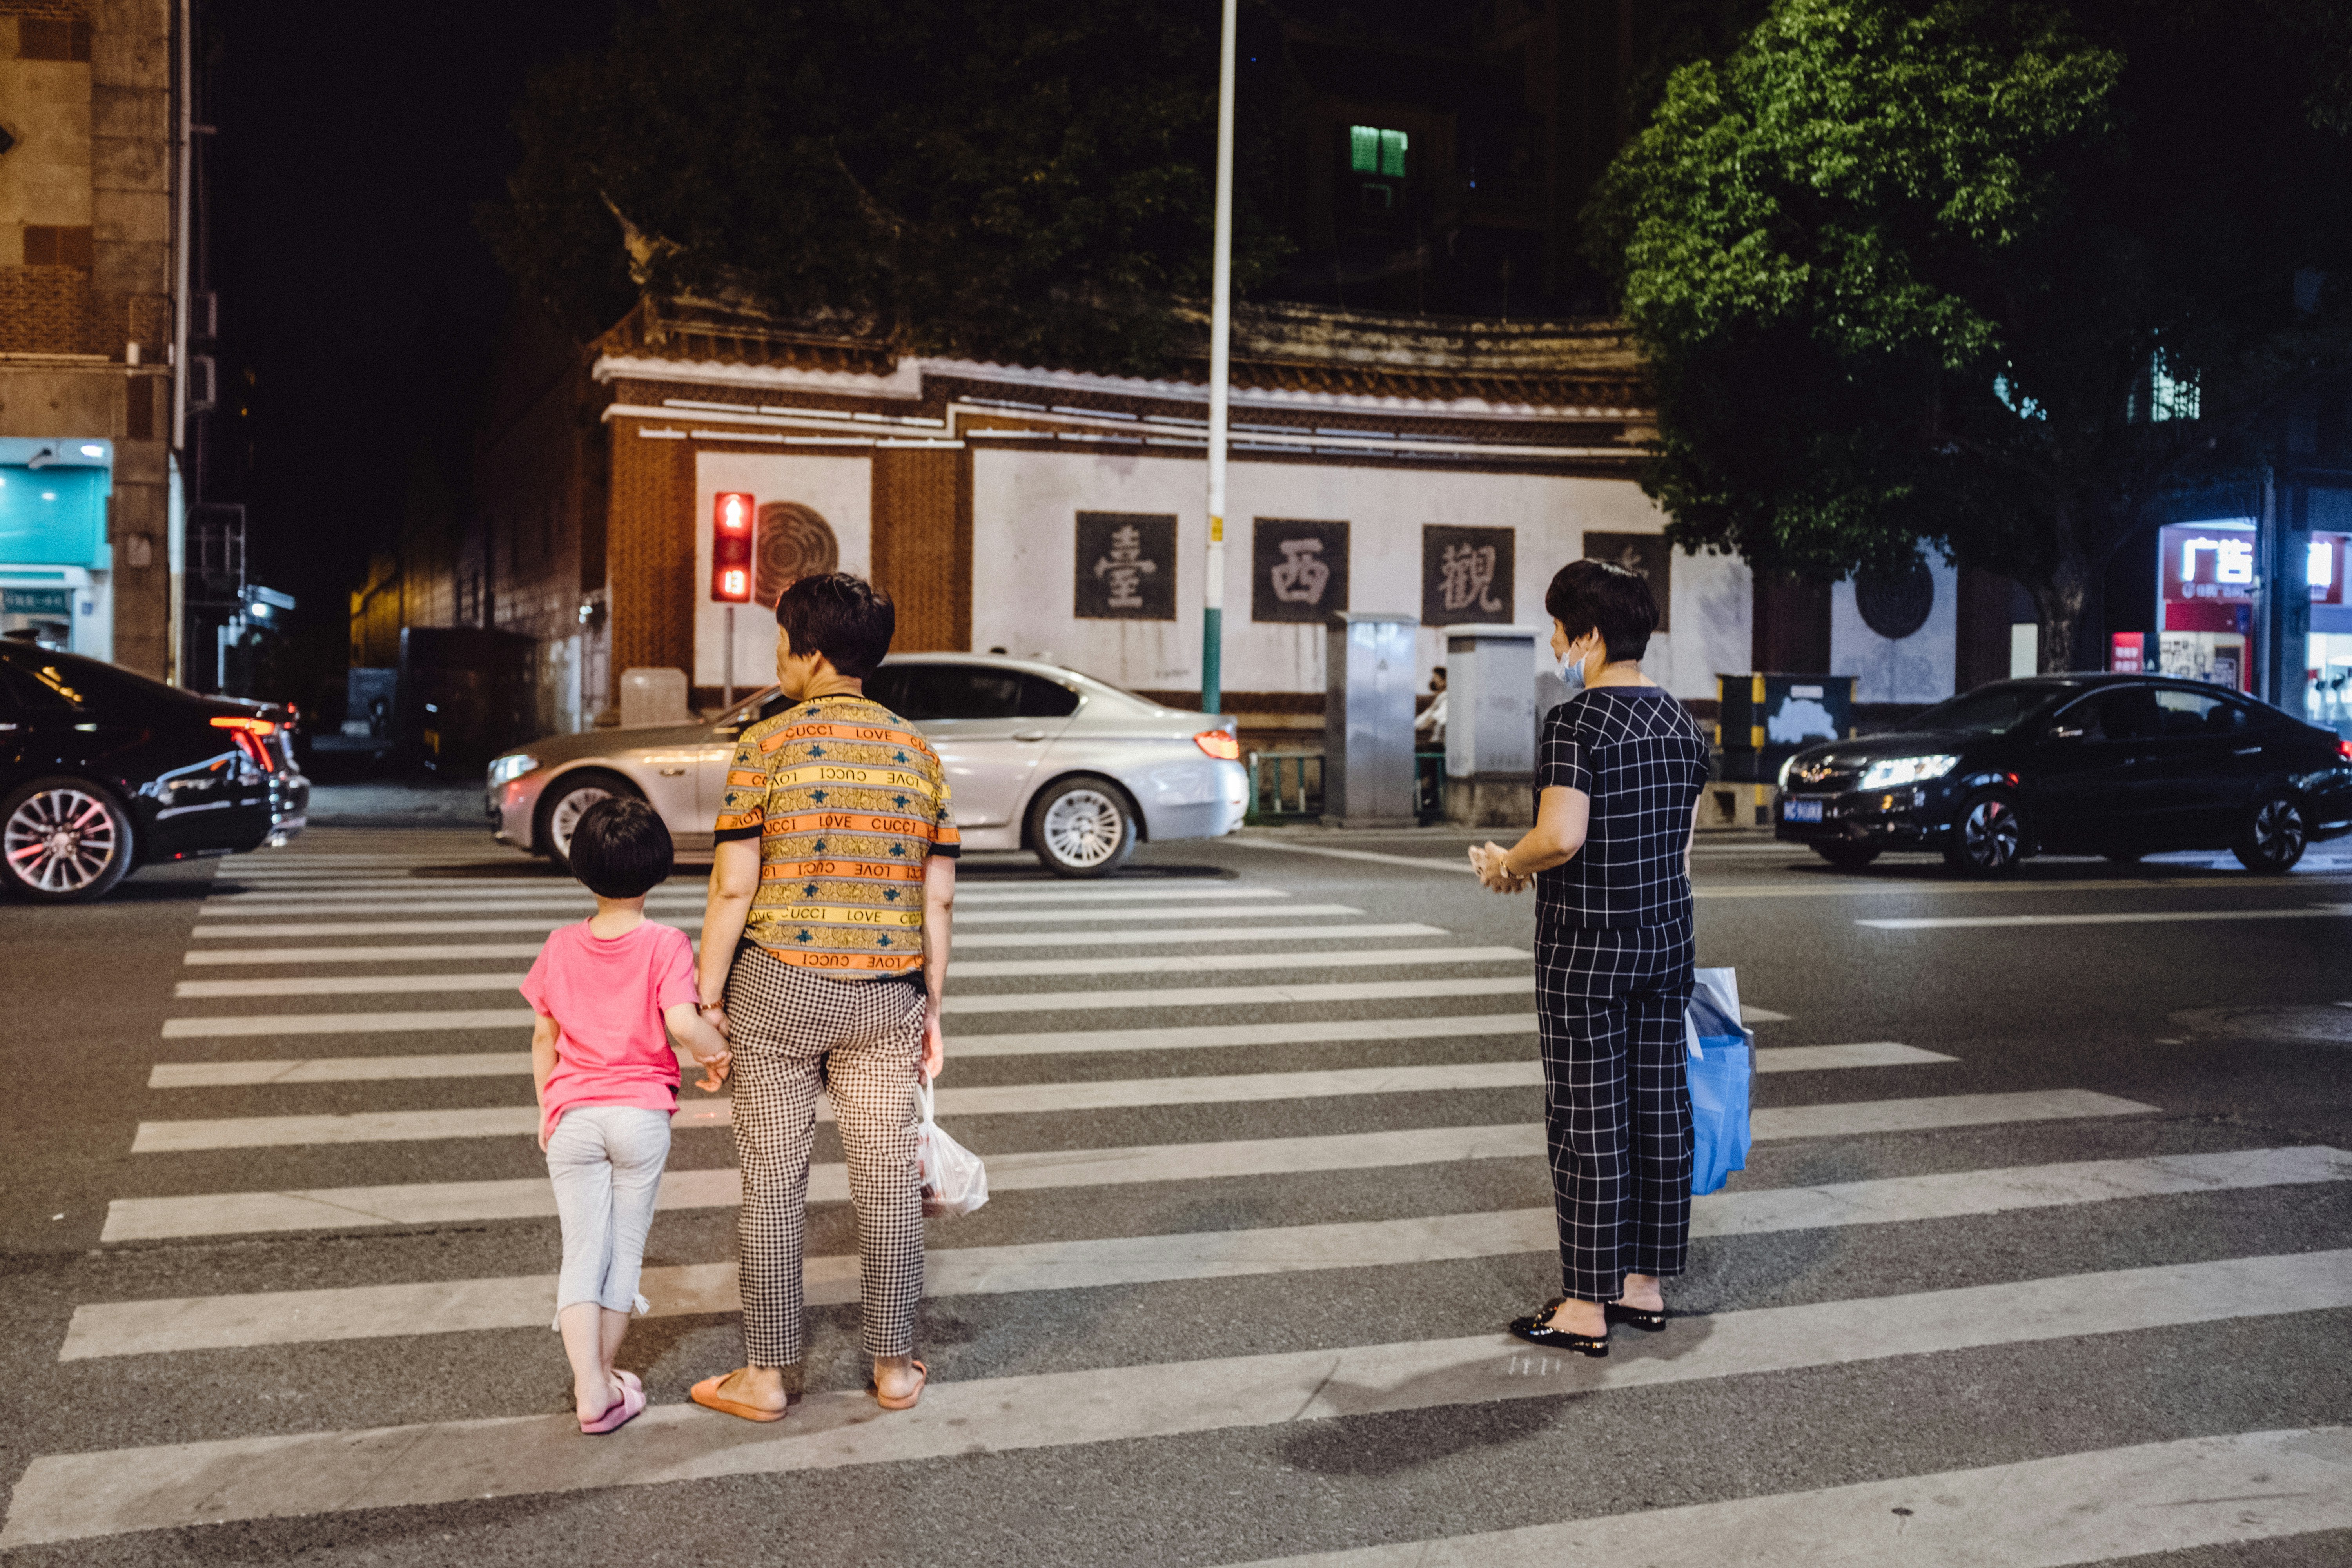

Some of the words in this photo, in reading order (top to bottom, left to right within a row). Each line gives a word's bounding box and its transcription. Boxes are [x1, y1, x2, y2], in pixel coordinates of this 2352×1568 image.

[2181, 537, 2253, 583] 广告
[1270, 537, 1330, 605] 西
[856, 728, 892, 740] LOVE
[771, 772, 797, 786] LOV
[887, 772, 919, 787] LOVE
[763, 819, 796, 834] UCCI
[819, 815, 852, 828] LOVE
[855, 864, 890, 877] LOVE
[750, 911, 775, 923] OVE
[847, 910, 882, 922] LOVE
[867, 956, 900, 968] LOVE
